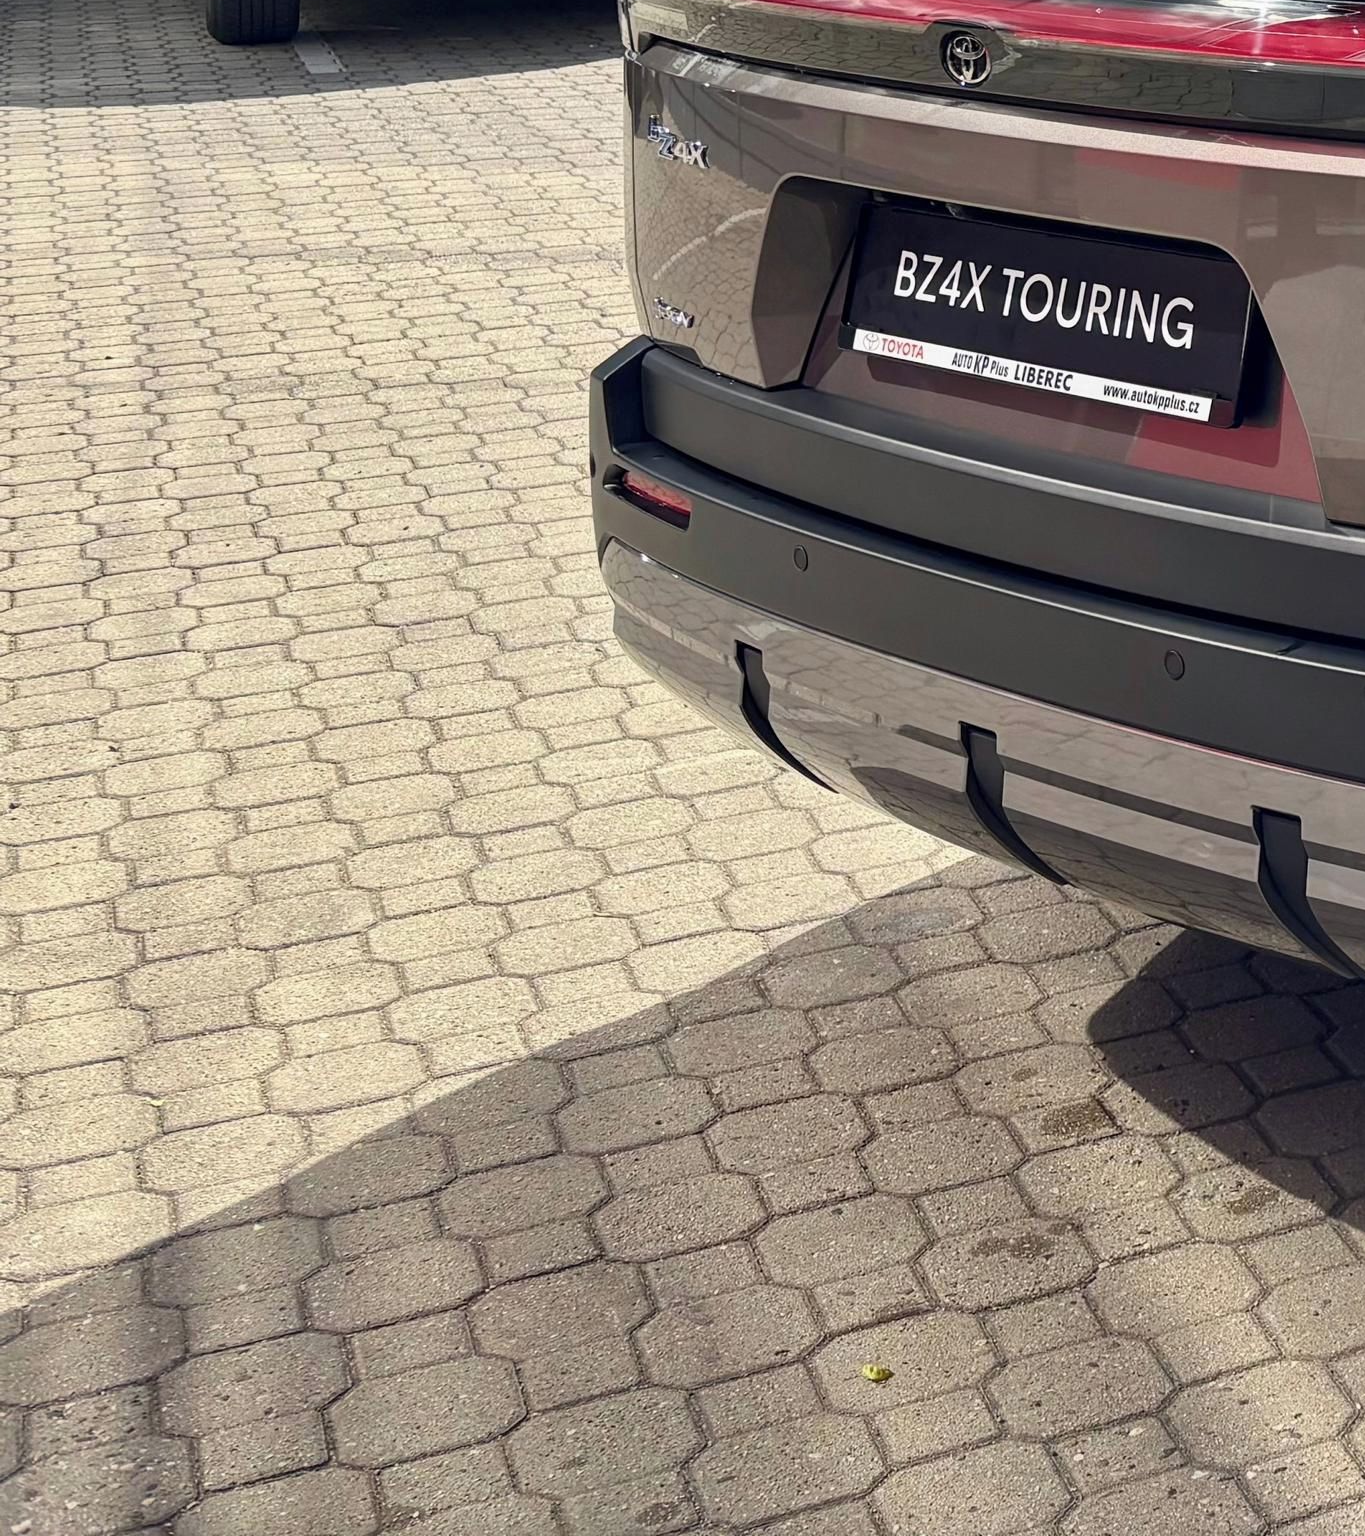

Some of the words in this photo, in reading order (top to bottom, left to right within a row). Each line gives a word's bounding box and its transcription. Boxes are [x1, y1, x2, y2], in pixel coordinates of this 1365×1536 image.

[893, 249, 993, 313] BZ4X
[1002, 267, 1195, 350] TOURING
[881, 338, 925, 360] TOYOTA
[951, 351, 974, 370] AUTO
[973, 353, 990, 376] KP
[990, 360, 1010, 379] Plus
[1013, 363, 1074, 392] LIBEREC
[1103, 383, 1201, 415] www.autokpplus.cz
